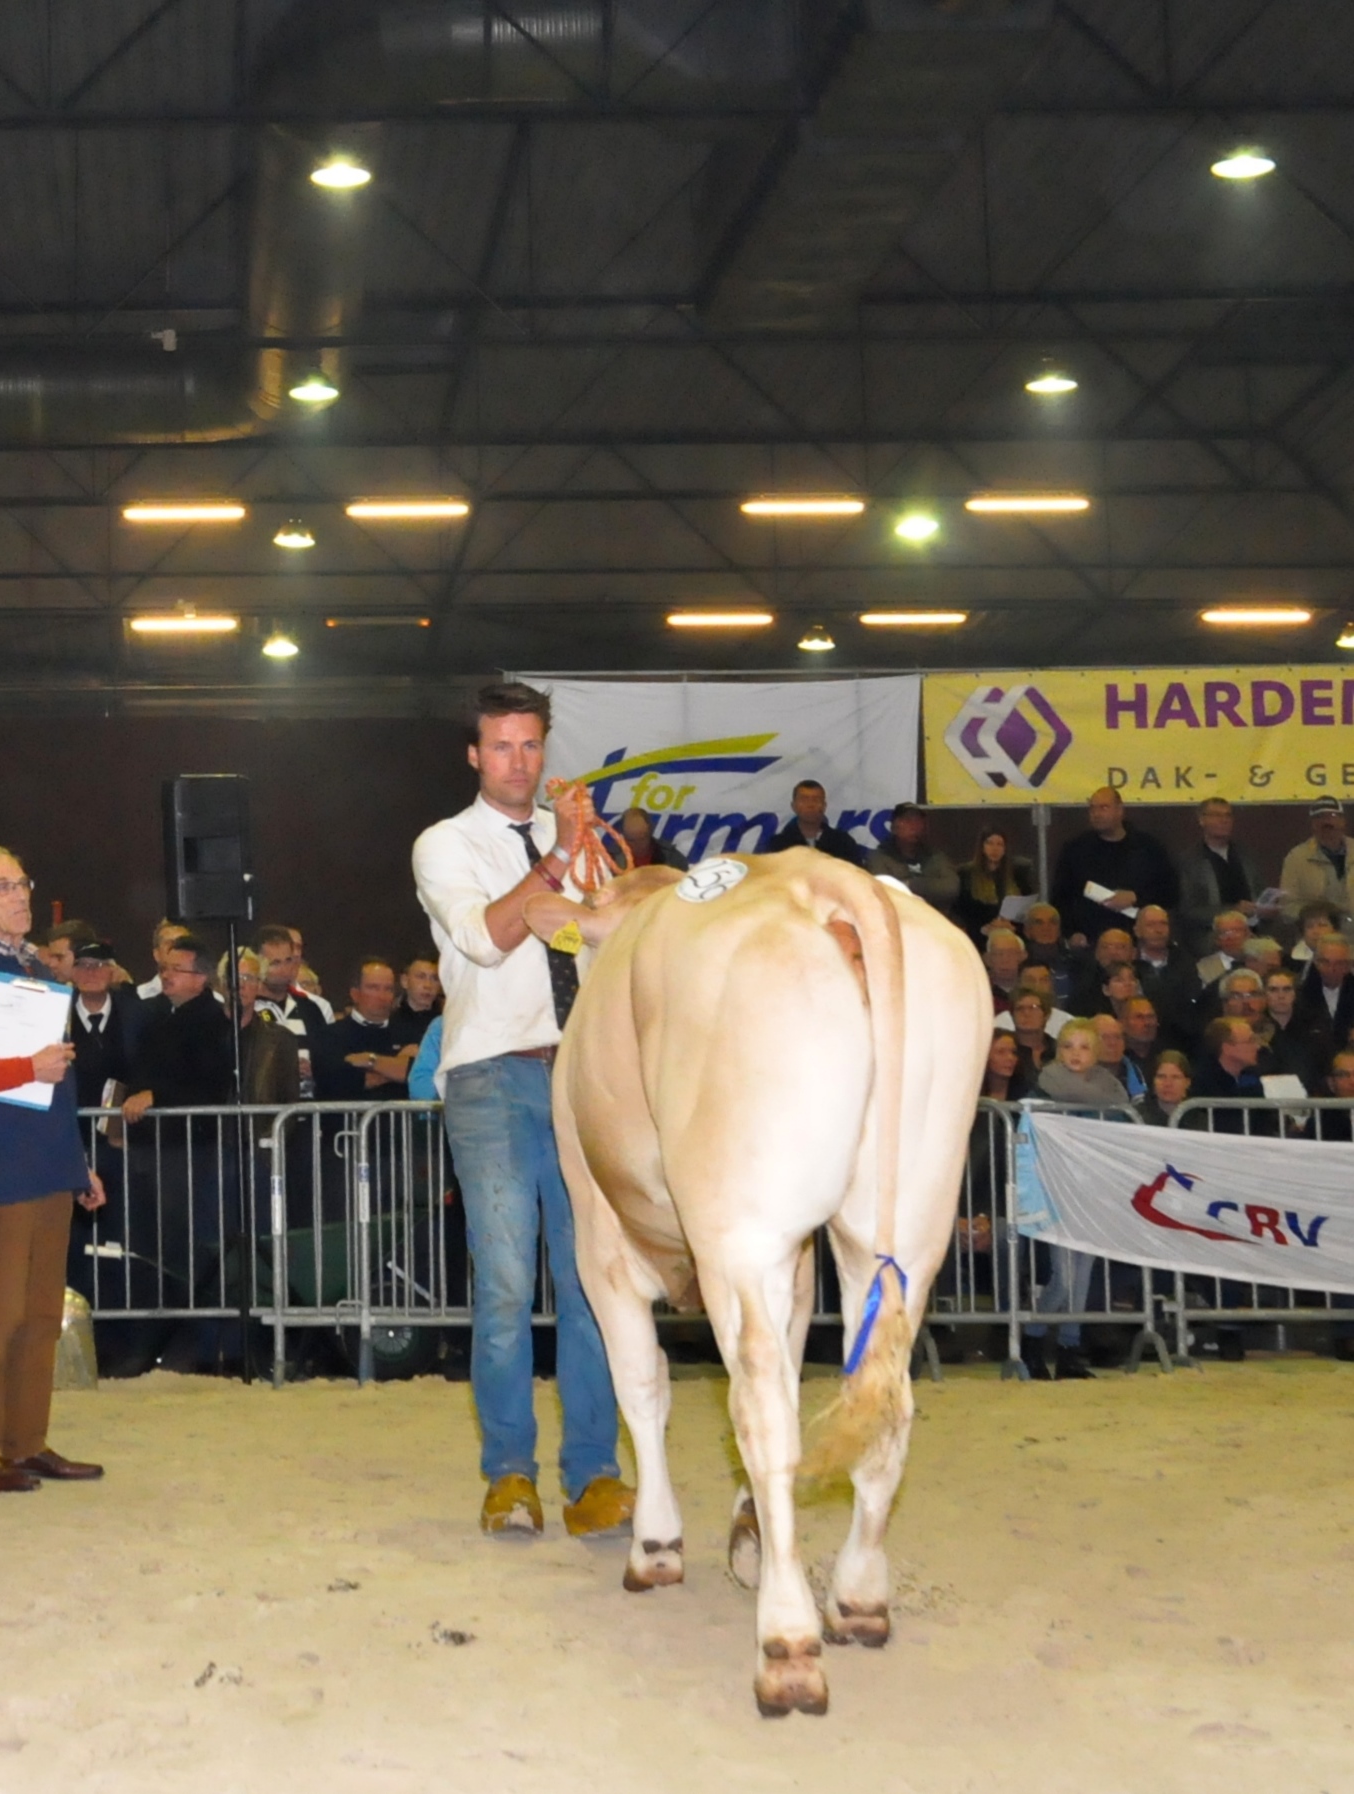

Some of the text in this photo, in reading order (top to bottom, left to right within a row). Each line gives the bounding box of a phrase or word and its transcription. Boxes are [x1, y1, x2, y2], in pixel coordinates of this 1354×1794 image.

[1105, 679, 1354, 729] HARDE
[630, 771, 696, 813] for
[1107, 765, 1218, 790] DAK-
[1248, 763, 1275, 788] &
[1206, 1200, 1341, 1248] CRV
